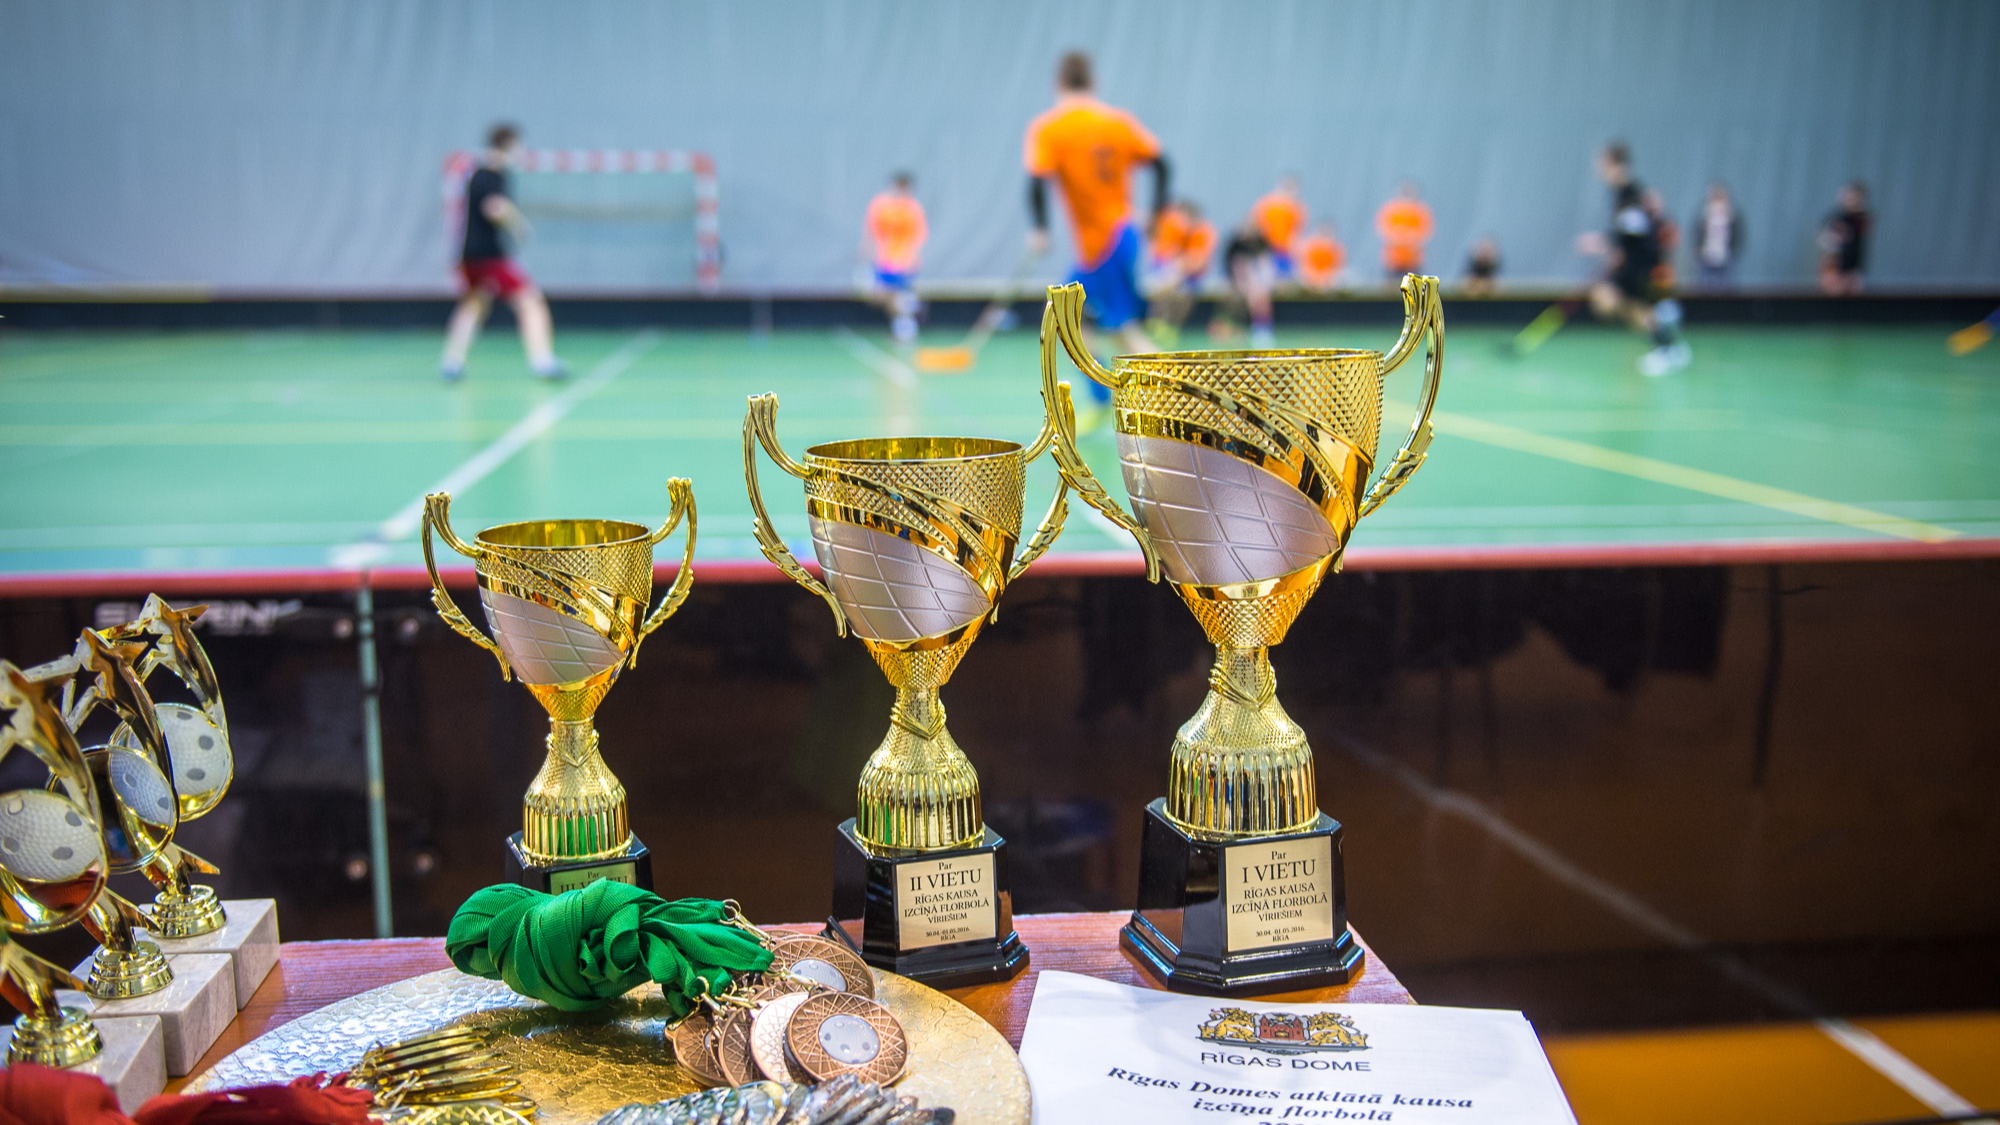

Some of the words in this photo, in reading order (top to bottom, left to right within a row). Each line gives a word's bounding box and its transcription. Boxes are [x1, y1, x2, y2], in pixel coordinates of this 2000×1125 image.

[1272, 851, 1286, 860] Par
[938, 862, 952, 871] Par
[1242, 867, 1249, 884] I
[1254, 859, 1316, 882] VIETU
[910, 876, 922, 891] II
[927, 868, 982, 889] VIETU
[915, 892, 944, 905] RĪGAS
[946, 889, 978, 901] KAUSA
[1244, 885, 1277, 900] RĪGAS
[1279, 882, 1315, 895] KAUSA
[904, 903, 938, 918] IZCĪŅĀ
[940, 898, 990, 913] FLORBOLĀ
[1232, 900, 1270, 914] IZCĪŅĀ
[1273, 894, 1328, 910] FLORBOLĀ
[928, 912, 967, 924] VĪRIEŠIEM
[1258, 909, 1303, 922] VĪRIEŠIEM
[1291, 1058, 1372, 1072] DOME
[1106, 1067, 1180, 1089] Rīgas
[1189, 1081, 1280, 1099] Domes
[1289, 1090, 1383, 1105] atklātā
[1393, 1093, 1474, 1108] kausa
[1278, 1104, 1394, 1121] florbolā
